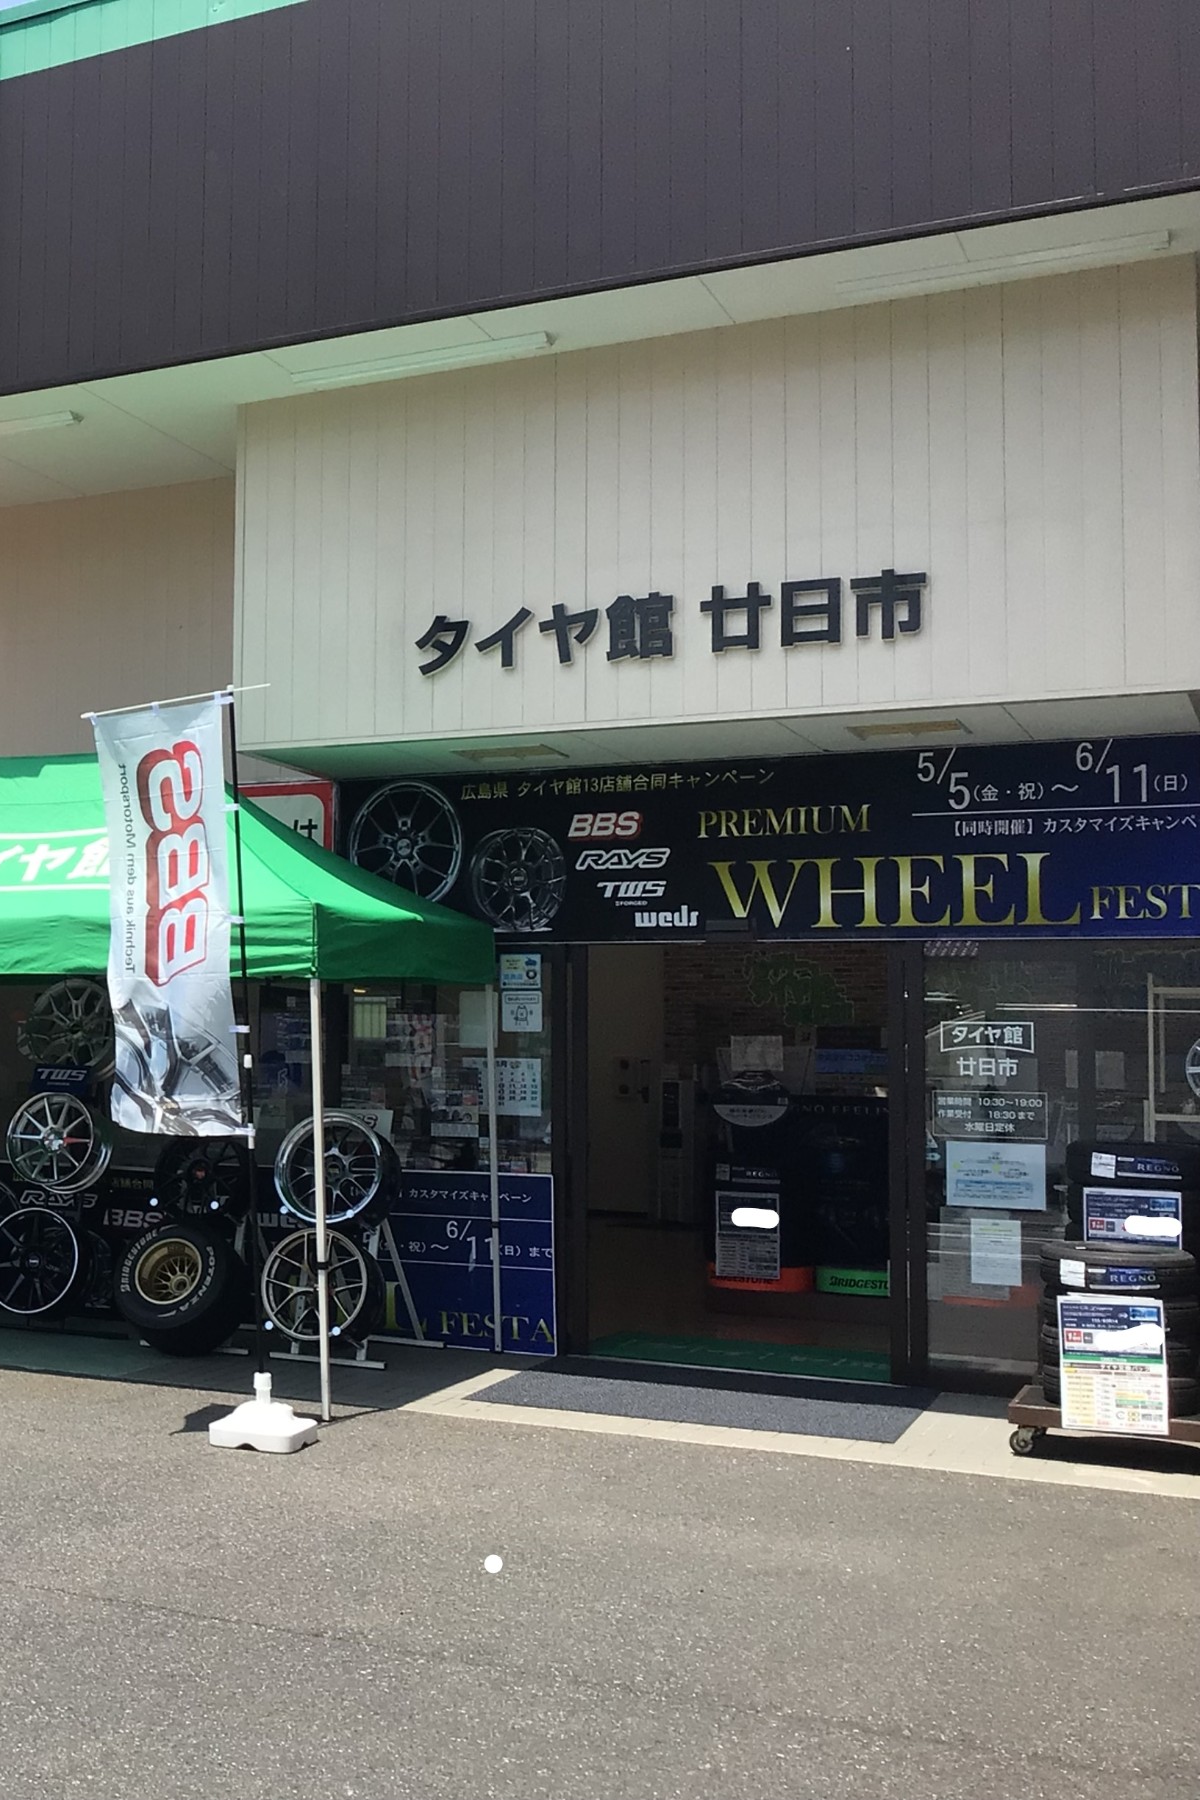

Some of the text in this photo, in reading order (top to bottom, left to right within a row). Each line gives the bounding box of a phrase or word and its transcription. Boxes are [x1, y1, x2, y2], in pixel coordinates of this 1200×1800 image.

[415, 567, 927, 677] タイヤ館 廿日市
[460, 768, 775, 801] 広島県 タイヤ館13店舗合同キャンペーン
[567, 810, 643, 842] BBS
[697, 804, 872, 839] PREMIUM
[575, 847, 671, 871] RAYS
[597, 880, 667, 899] TWS
[707, 852, 1082, 929] WHEEL
[634, 905, 700, 928] weds
[951, 1026, 1024, 1045] タイヤ館
[36, 1068, 88, 1081] TWS
[956, 1057, 1019, 1077] 廿日市
[1136, 1162, 1180, 1173] REGNO
[408, 1188, 532, 1203] カスタマイズキャペーン
[119, 1228, 159, 1293] BRIDGESTONE
[178, 1245, 217, 1312] POTENZA
[1109, 1273, 1157, 1283] REGNO
